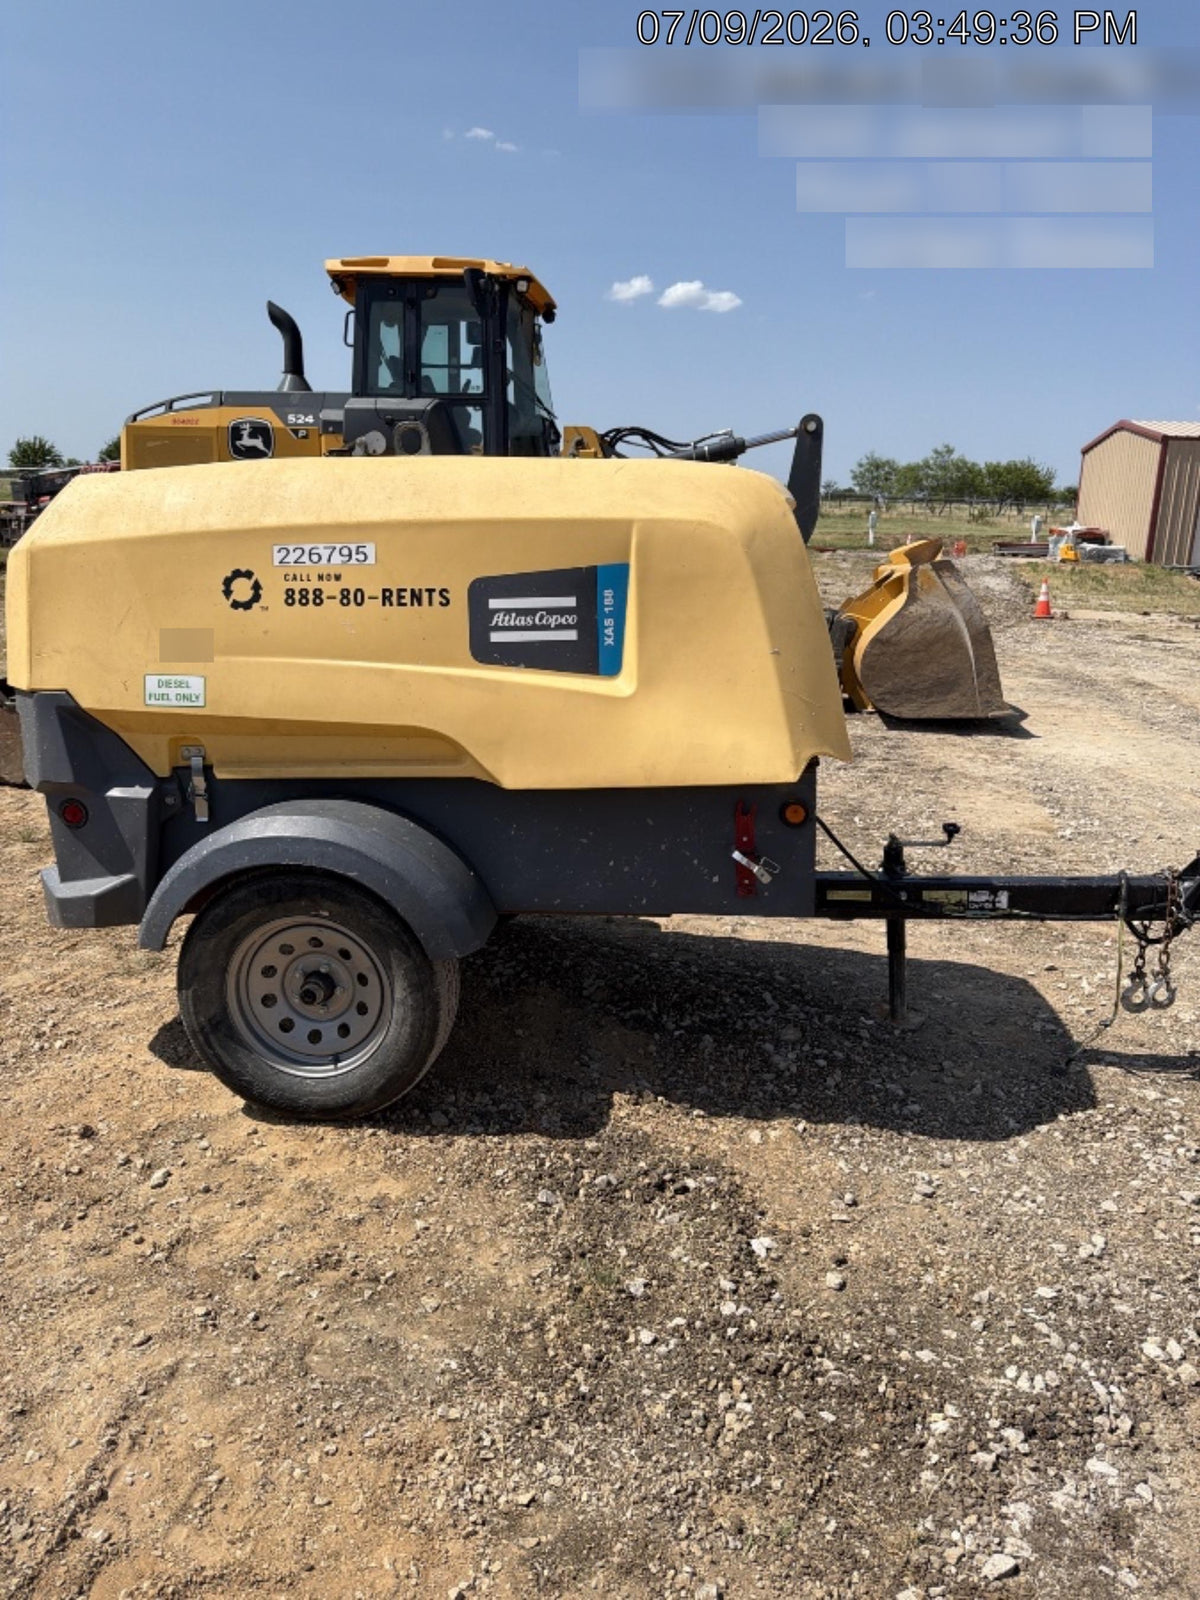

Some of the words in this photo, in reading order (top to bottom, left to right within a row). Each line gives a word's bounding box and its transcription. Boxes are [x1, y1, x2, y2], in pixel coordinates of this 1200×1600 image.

[287, 414, 315, 424] 524
[298, 429, 307, 438] P
[276, 545, 369, 565] 226795
[283, 573, 312, 582] CALL
[317, 573, 342, 582] NOW
[284, 588, 451, 608] 888-80-RENTS
[157, 679, 191, 689] DIESEL
[148, 693, 172, 701] FUEL
[175, 693, 201, 702] ONLY
